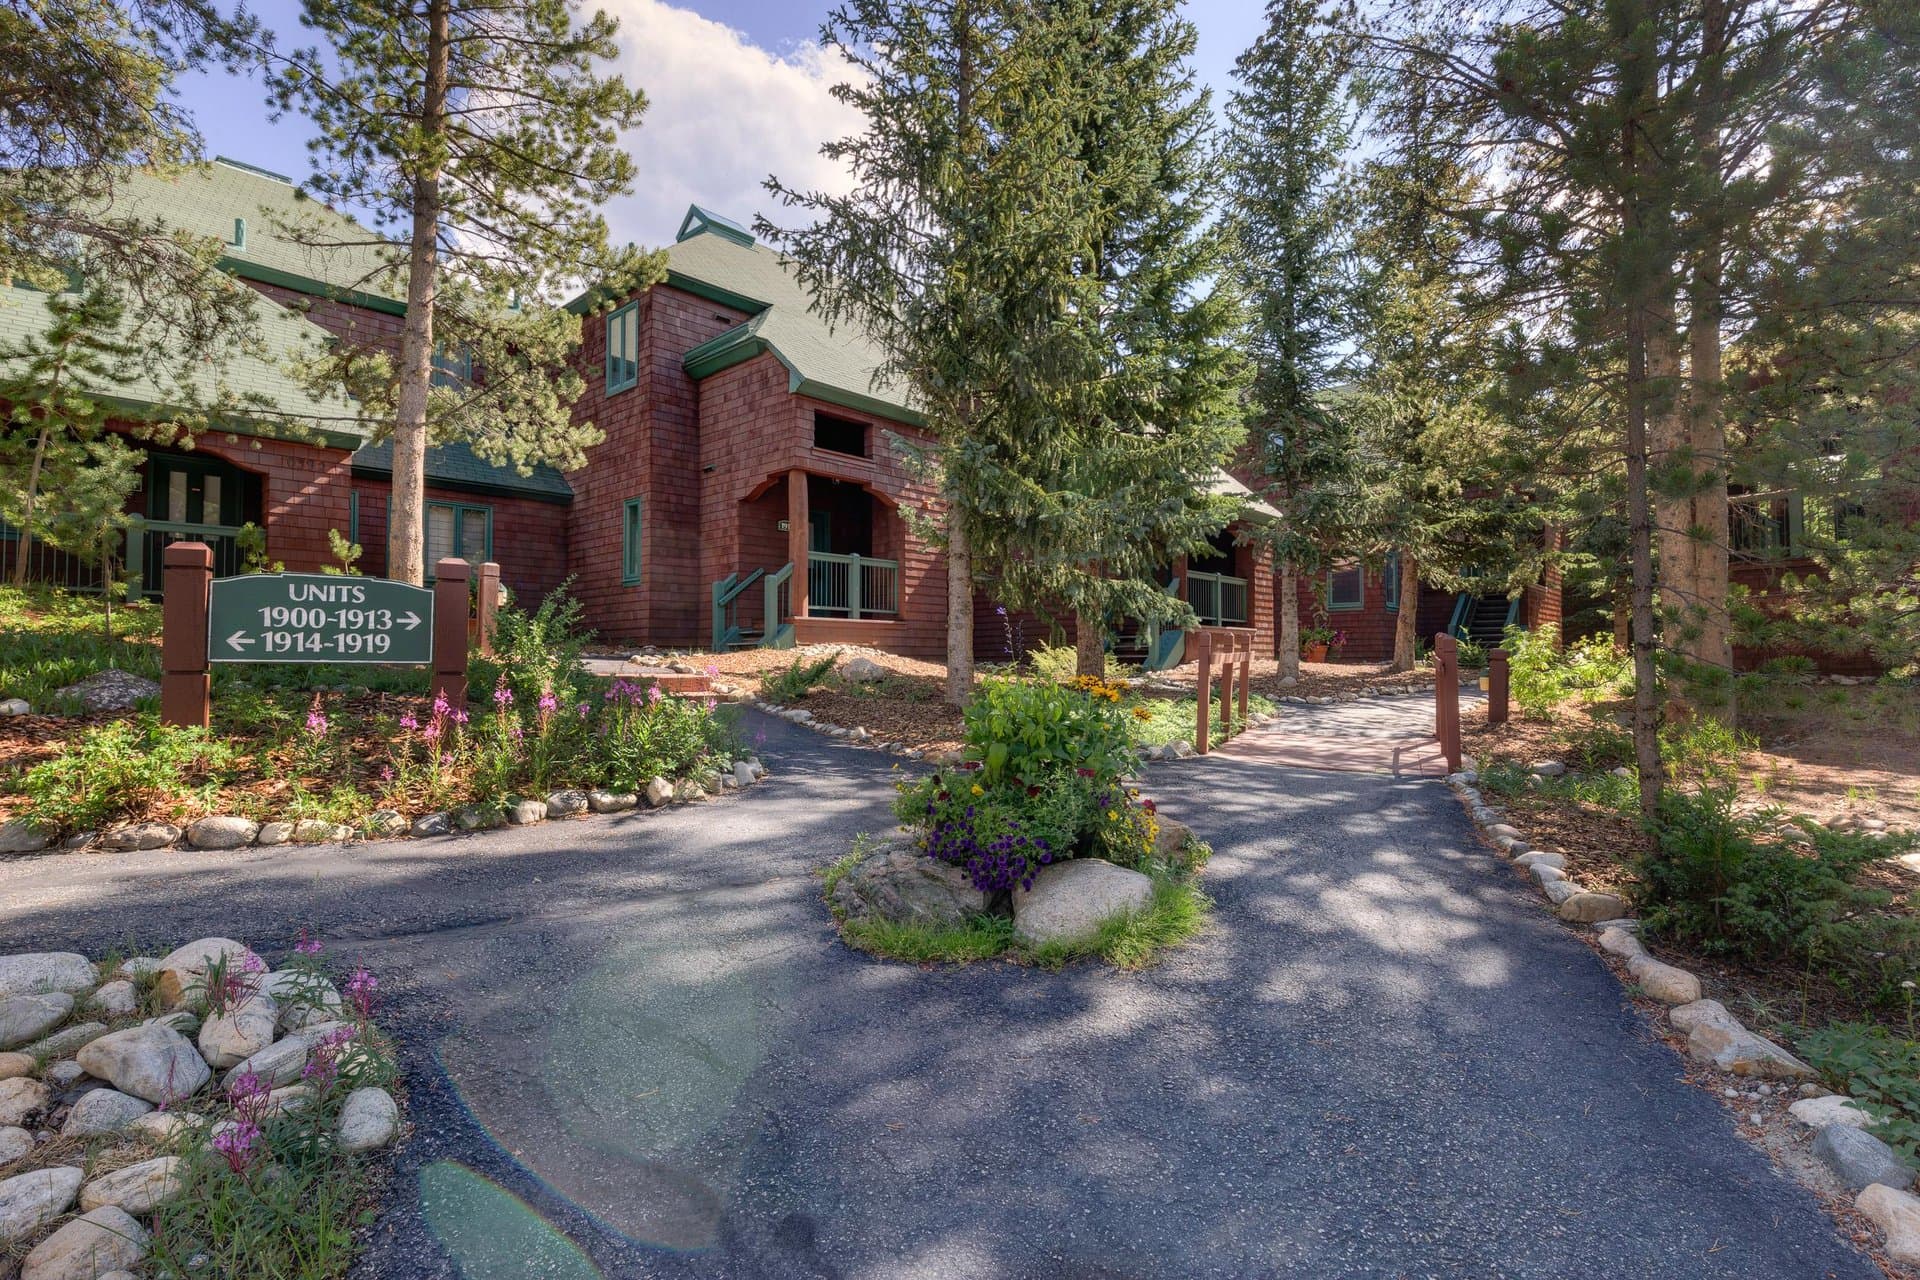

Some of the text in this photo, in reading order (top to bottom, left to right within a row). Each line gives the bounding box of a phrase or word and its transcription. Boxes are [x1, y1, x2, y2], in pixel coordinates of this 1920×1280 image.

[288, 583, 366, 604] UNITS
[257, 606, 393, 630] 1900-1913
[260, 631, 391, 654] 1914-1919
